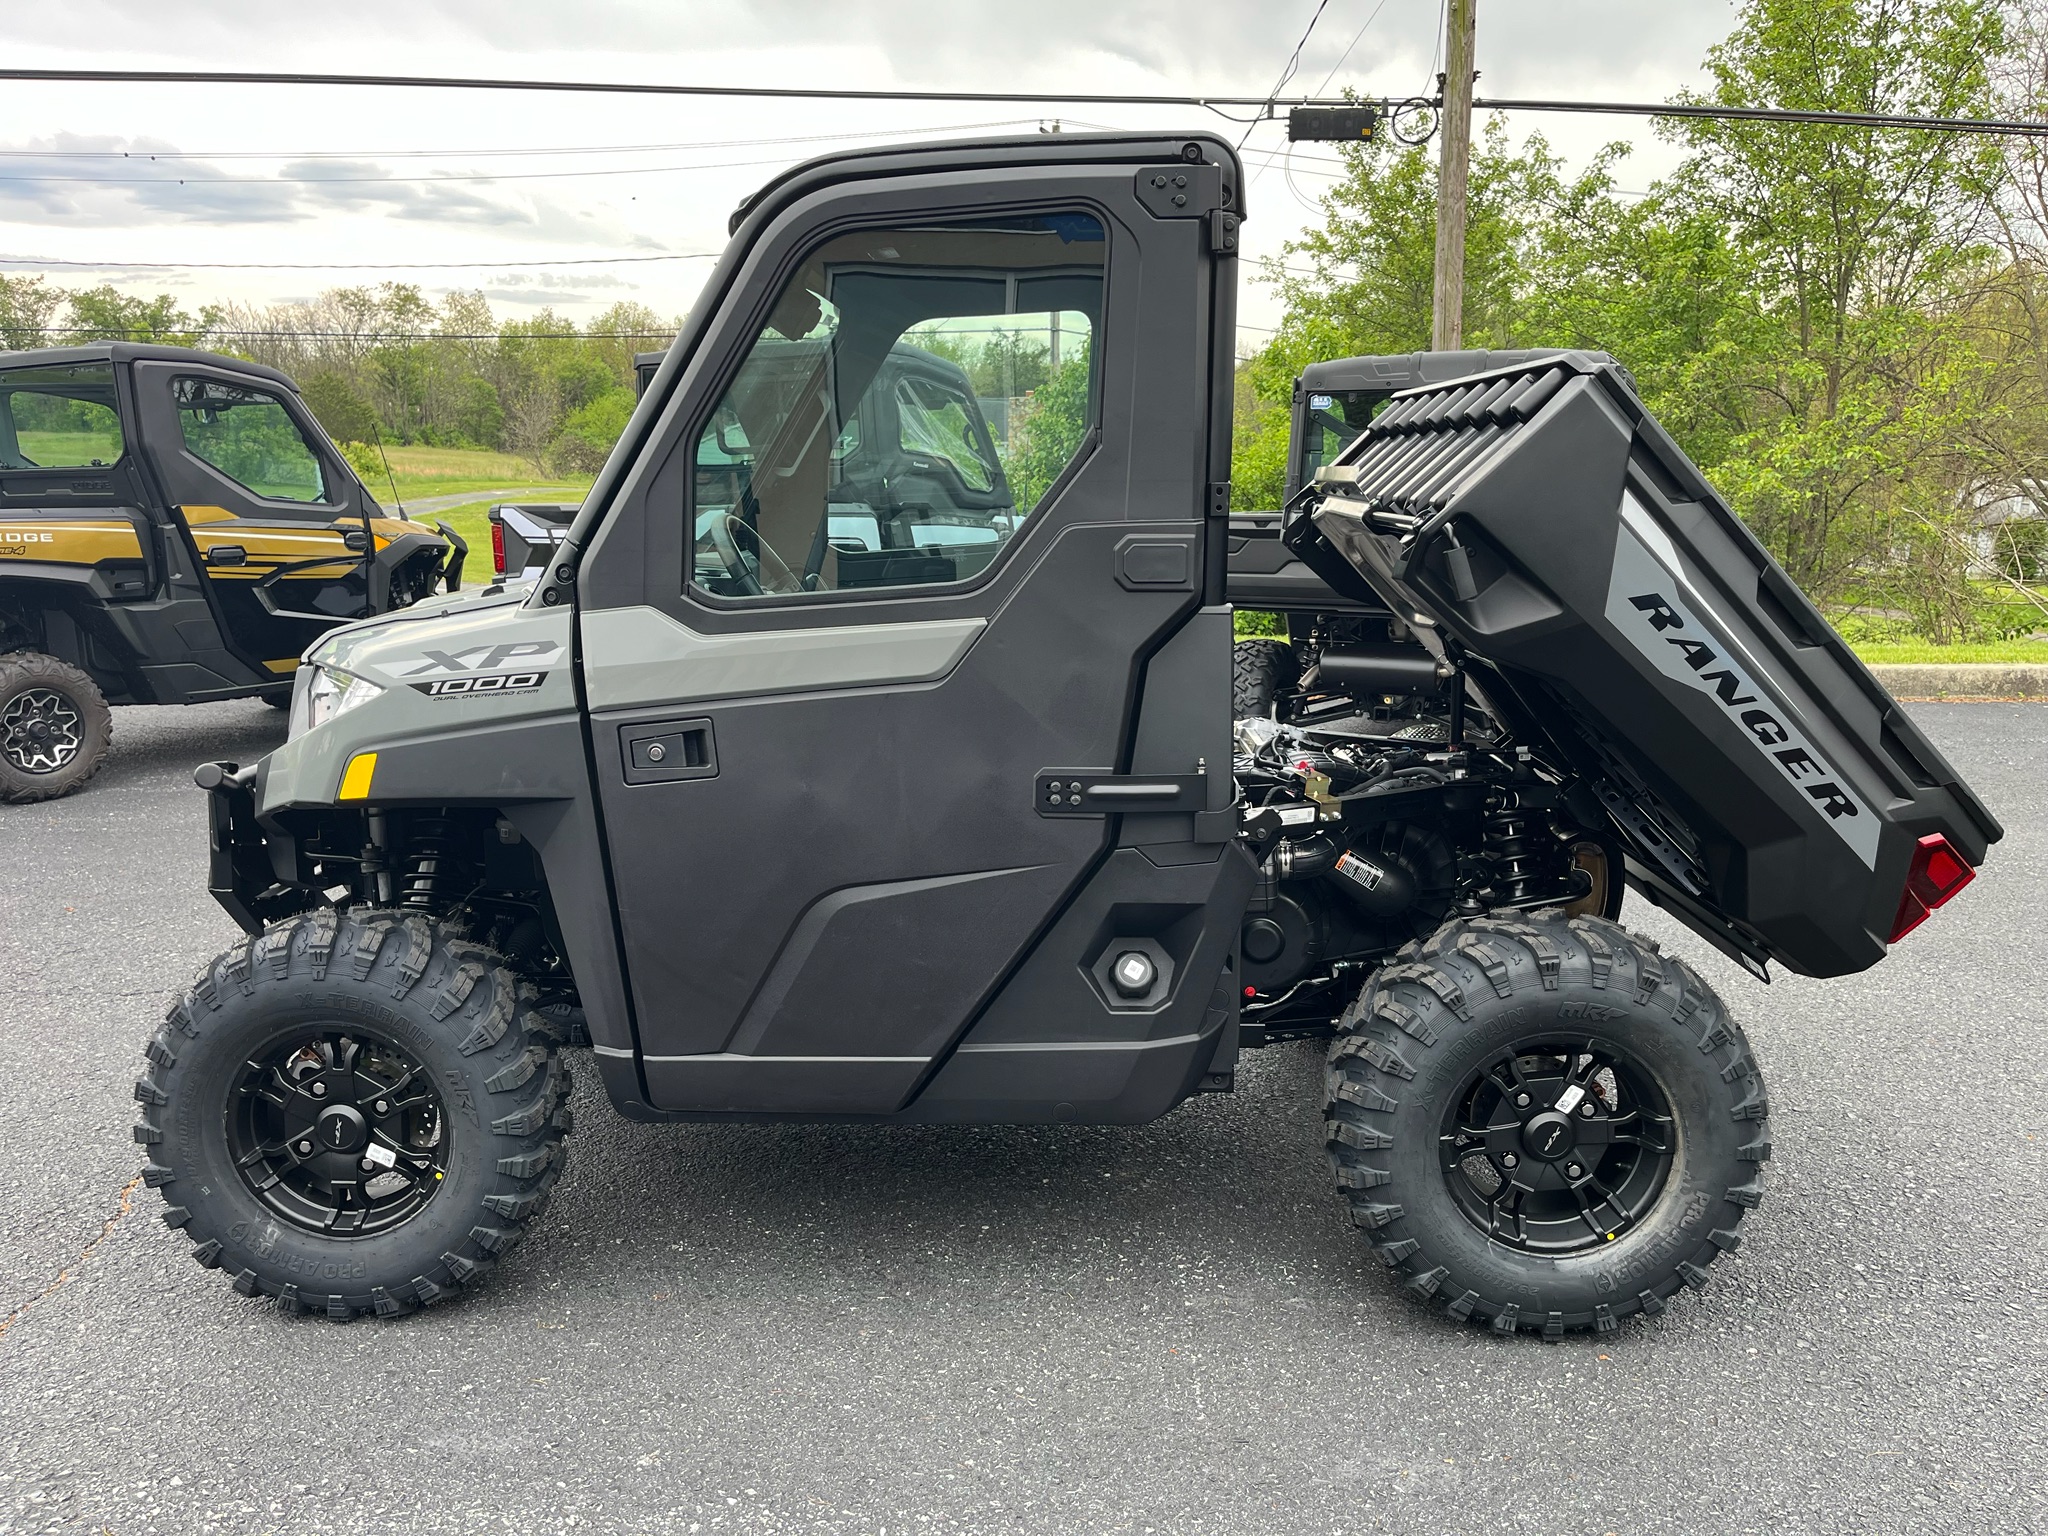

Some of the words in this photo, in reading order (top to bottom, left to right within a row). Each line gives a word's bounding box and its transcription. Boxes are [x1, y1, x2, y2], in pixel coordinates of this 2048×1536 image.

[400, 640, 559, 676] XP
[429, 673, 539, 695] 1000
[462, 690, 515, 699] OVERHEAD
[1627, 592, 1859, 820] RANGER
[295, 991, 435, 1051] X-TERRAIN
[1411, 1006, 1528, 1112] X-TERRAIN
[1681, 1190, 1711, 1230] PRO
[323, 1262, 366, 1279] PRO
